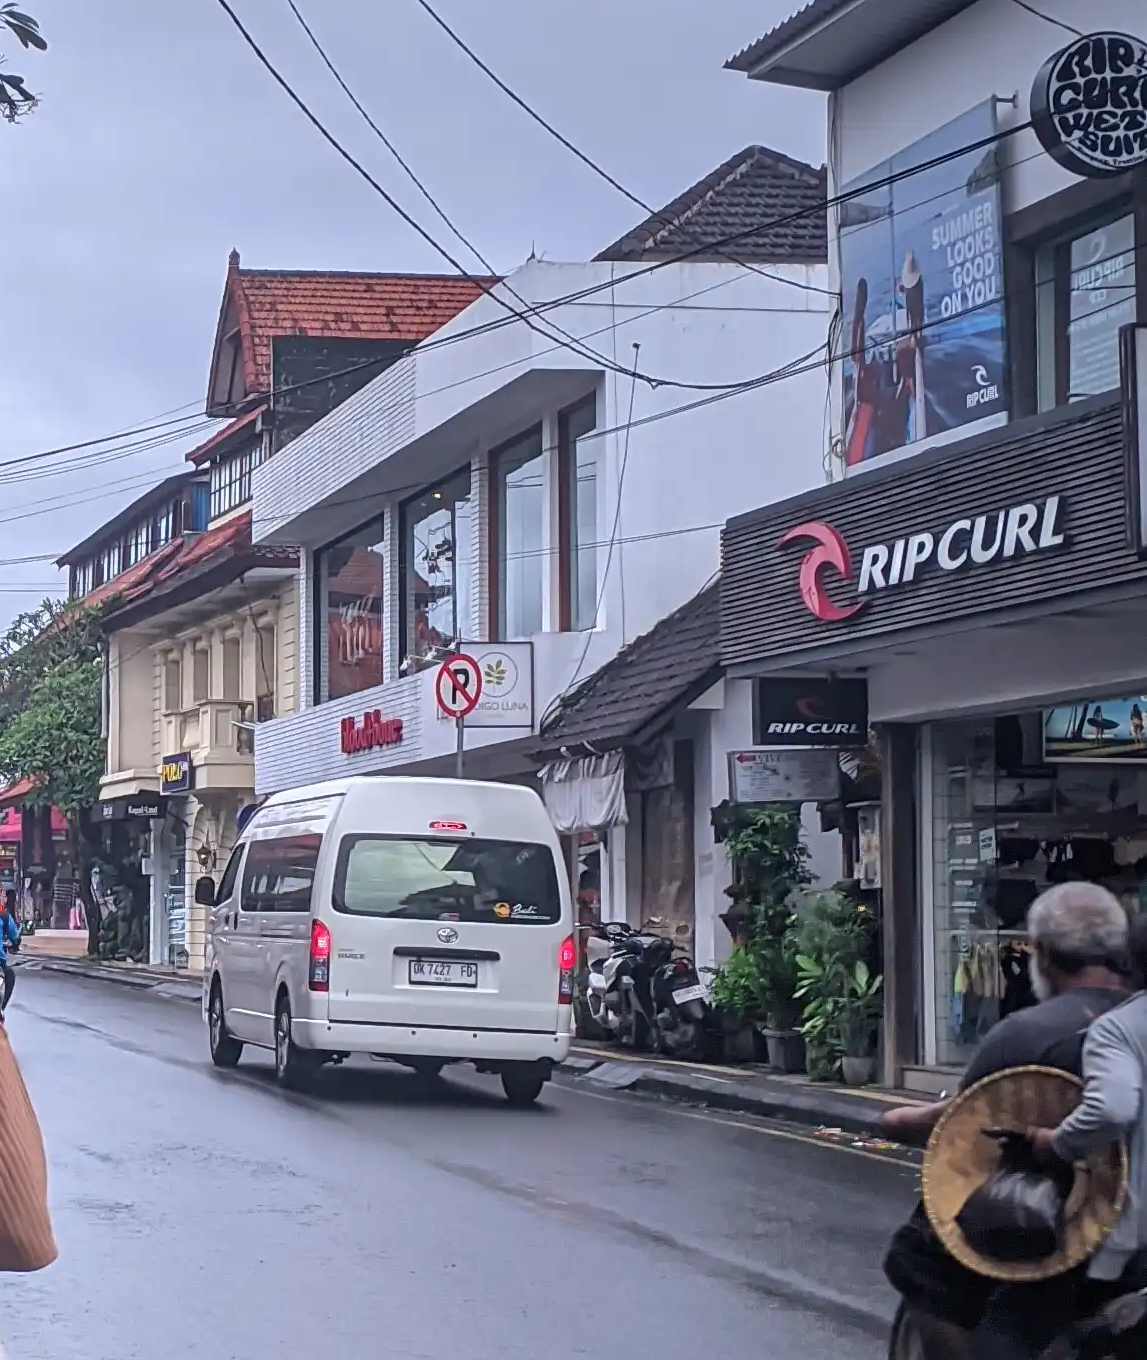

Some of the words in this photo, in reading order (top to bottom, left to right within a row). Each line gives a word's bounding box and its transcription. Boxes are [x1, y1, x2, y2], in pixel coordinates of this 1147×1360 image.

[1056, 37, 1135, 82] RIP
[932, 202, 992, 250] SUMMER
[947, 226, 994, 268] LOOKS
[953, 252, 995, 289] GOOD
[941, 293, 962, 319] ON
[966, 275, 996, 308] YOU
[857, 531, 935, 593] RIP
[937, 495, 1066, 570] CURL
[767, 722, 805, 734] RIP
[806, 722, 861, 734] CURL
[413, 962, 426, 976] DK
[427, 963, 451, 976] 7427
